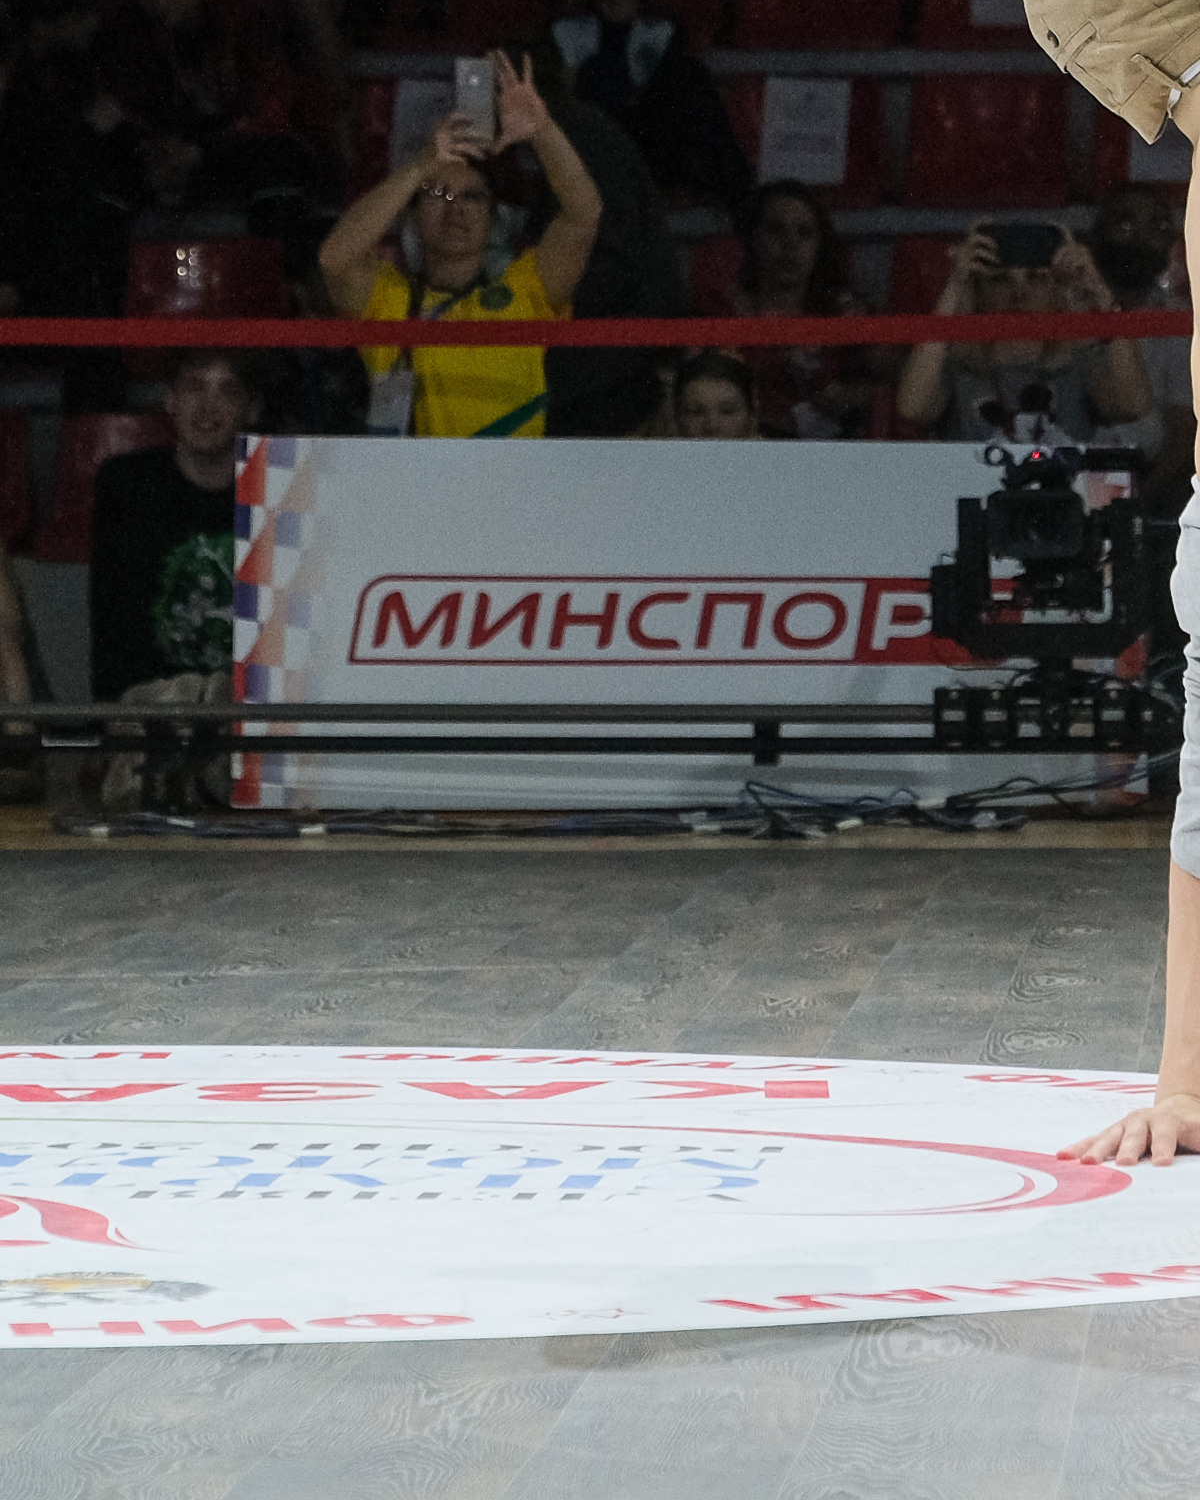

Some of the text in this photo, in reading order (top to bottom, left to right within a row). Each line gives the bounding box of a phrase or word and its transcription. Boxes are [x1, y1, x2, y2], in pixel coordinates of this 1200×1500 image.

[373, 591, 1013, 650] МИНСПОР
[340, 1053, 844, 1070] ФИНАЛ
[0, 1080, 830, 1103] КАЗА
[10, 1312, 473, 1337] ФИН
